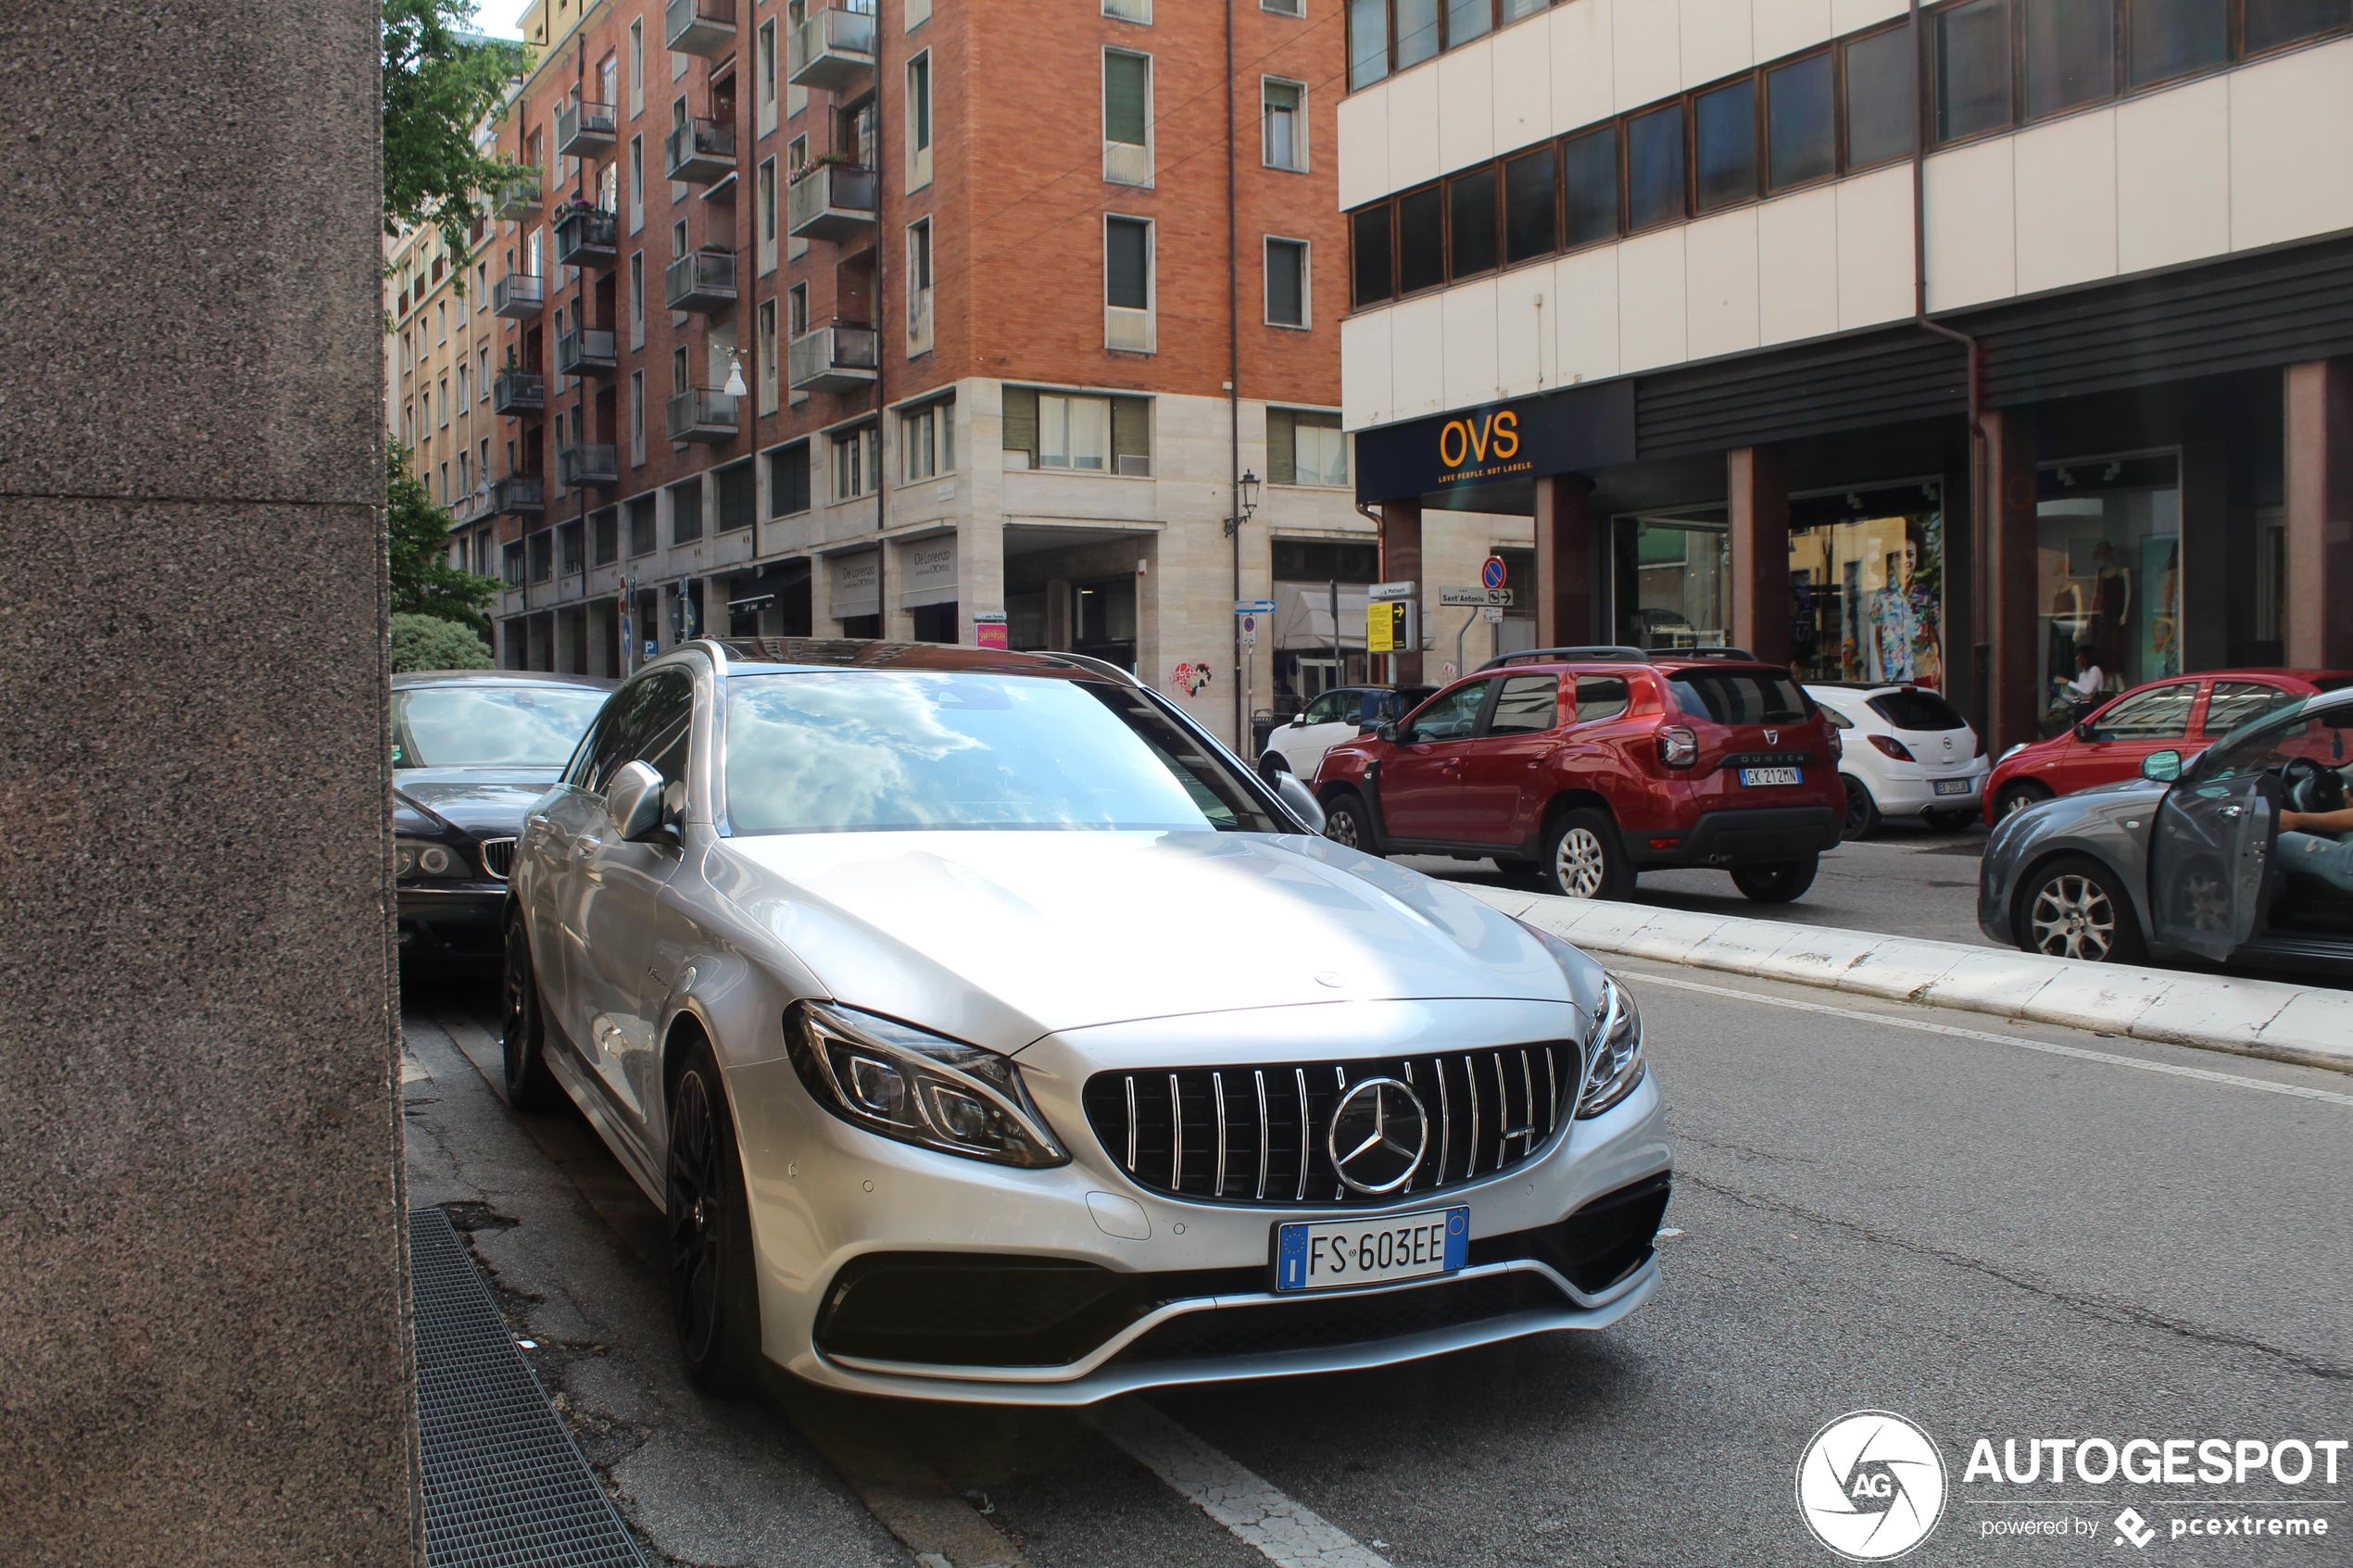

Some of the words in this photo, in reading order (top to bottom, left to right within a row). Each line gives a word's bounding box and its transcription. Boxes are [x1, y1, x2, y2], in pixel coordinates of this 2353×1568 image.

[1441, 410, 1518, 468] OVS
[1439, 474, 1455, 483] LOVE
[1457, 470, 1485, 480] PEOPLE.
[1487, 466, 1501, 475] NOT
[1503, 461, 1533, 472] LABELS.
[914, 553, 924, 566] De
[925, 551, 950, 565] Lorenzo
[843, 567, 851, 580] De
[852, 565, 875, 579] Lorenzo
[1442, 594, 1485, 603] Sant'Antonio
[645, 641, 654, 652] P
[1741, 755, 1805, 763] DUSTER
